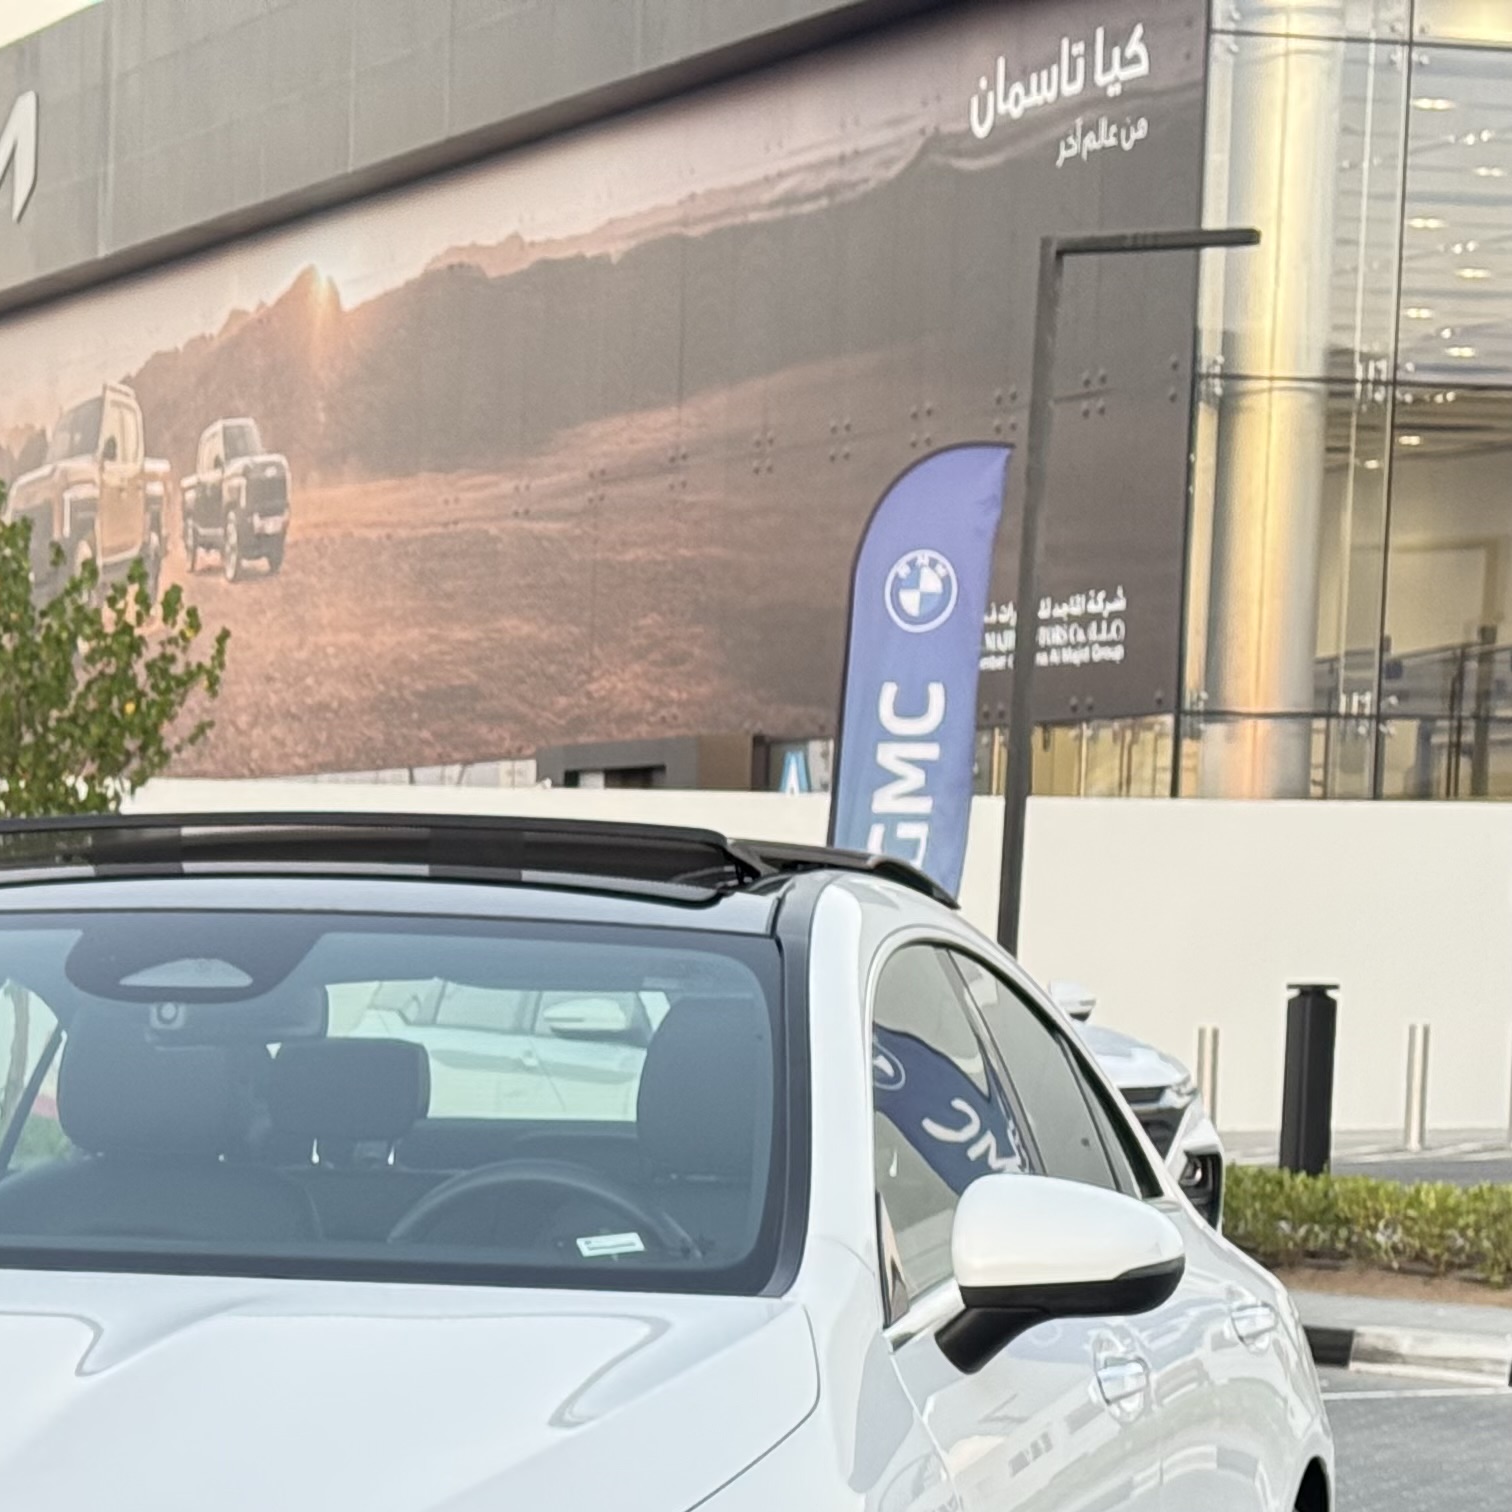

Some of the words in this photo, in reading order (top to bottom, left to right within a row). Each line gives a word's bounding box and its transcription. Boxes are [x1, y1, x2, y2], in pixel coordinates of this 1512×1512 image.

[970, 36, 1086, 139] تاسمان
[1094, 22, 1150, 97] كيا
[1120, 116, 1149, 151] من
[867, 682, 946, 870] GMC
